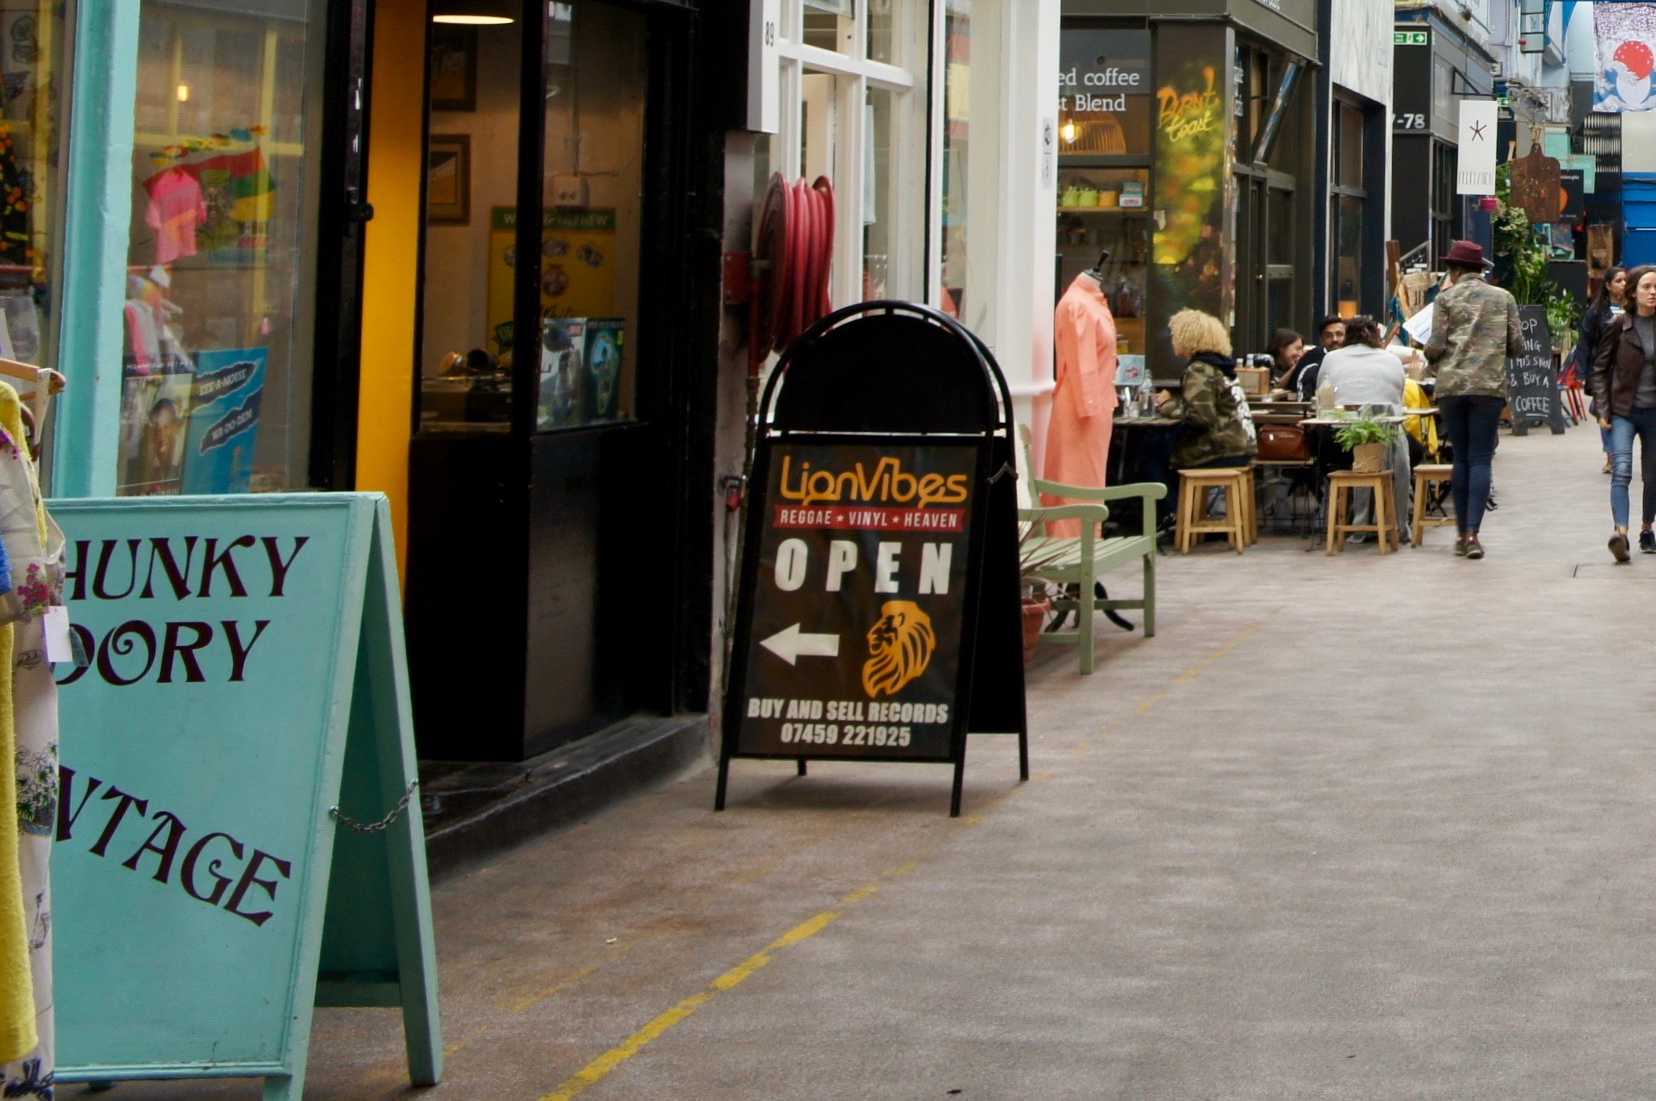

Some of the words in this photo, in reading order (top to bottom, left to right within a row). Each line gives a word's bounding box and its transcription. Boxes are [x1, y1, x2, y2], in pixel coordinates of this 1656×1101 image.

[765, 21, 774, 47] 89
[1084, 68, 1140, 86] coffee
[1075, 93, 1126, 112] Blend
[1523, 371, 1540, 387] BUY
[1516, 396, 1550, 412] COFFEE
[780, 455, 967, 509] LionVibes
[780, 509, 832, 526] REGGAE
[848, 511, 889, 527] VINYL
[904, 512, 958, 528] HEAVEN
[774, 537, 953, 596] OPEN
[748, 698, 785, 720] BUY
[787, 700, 823, 721] AND
[826, 701, 864, 722] SELL
[868, 702, 949, 725] RECORDS
[781, 725, 838, 745] 07459
[843, 726, 912, 747] 221925
